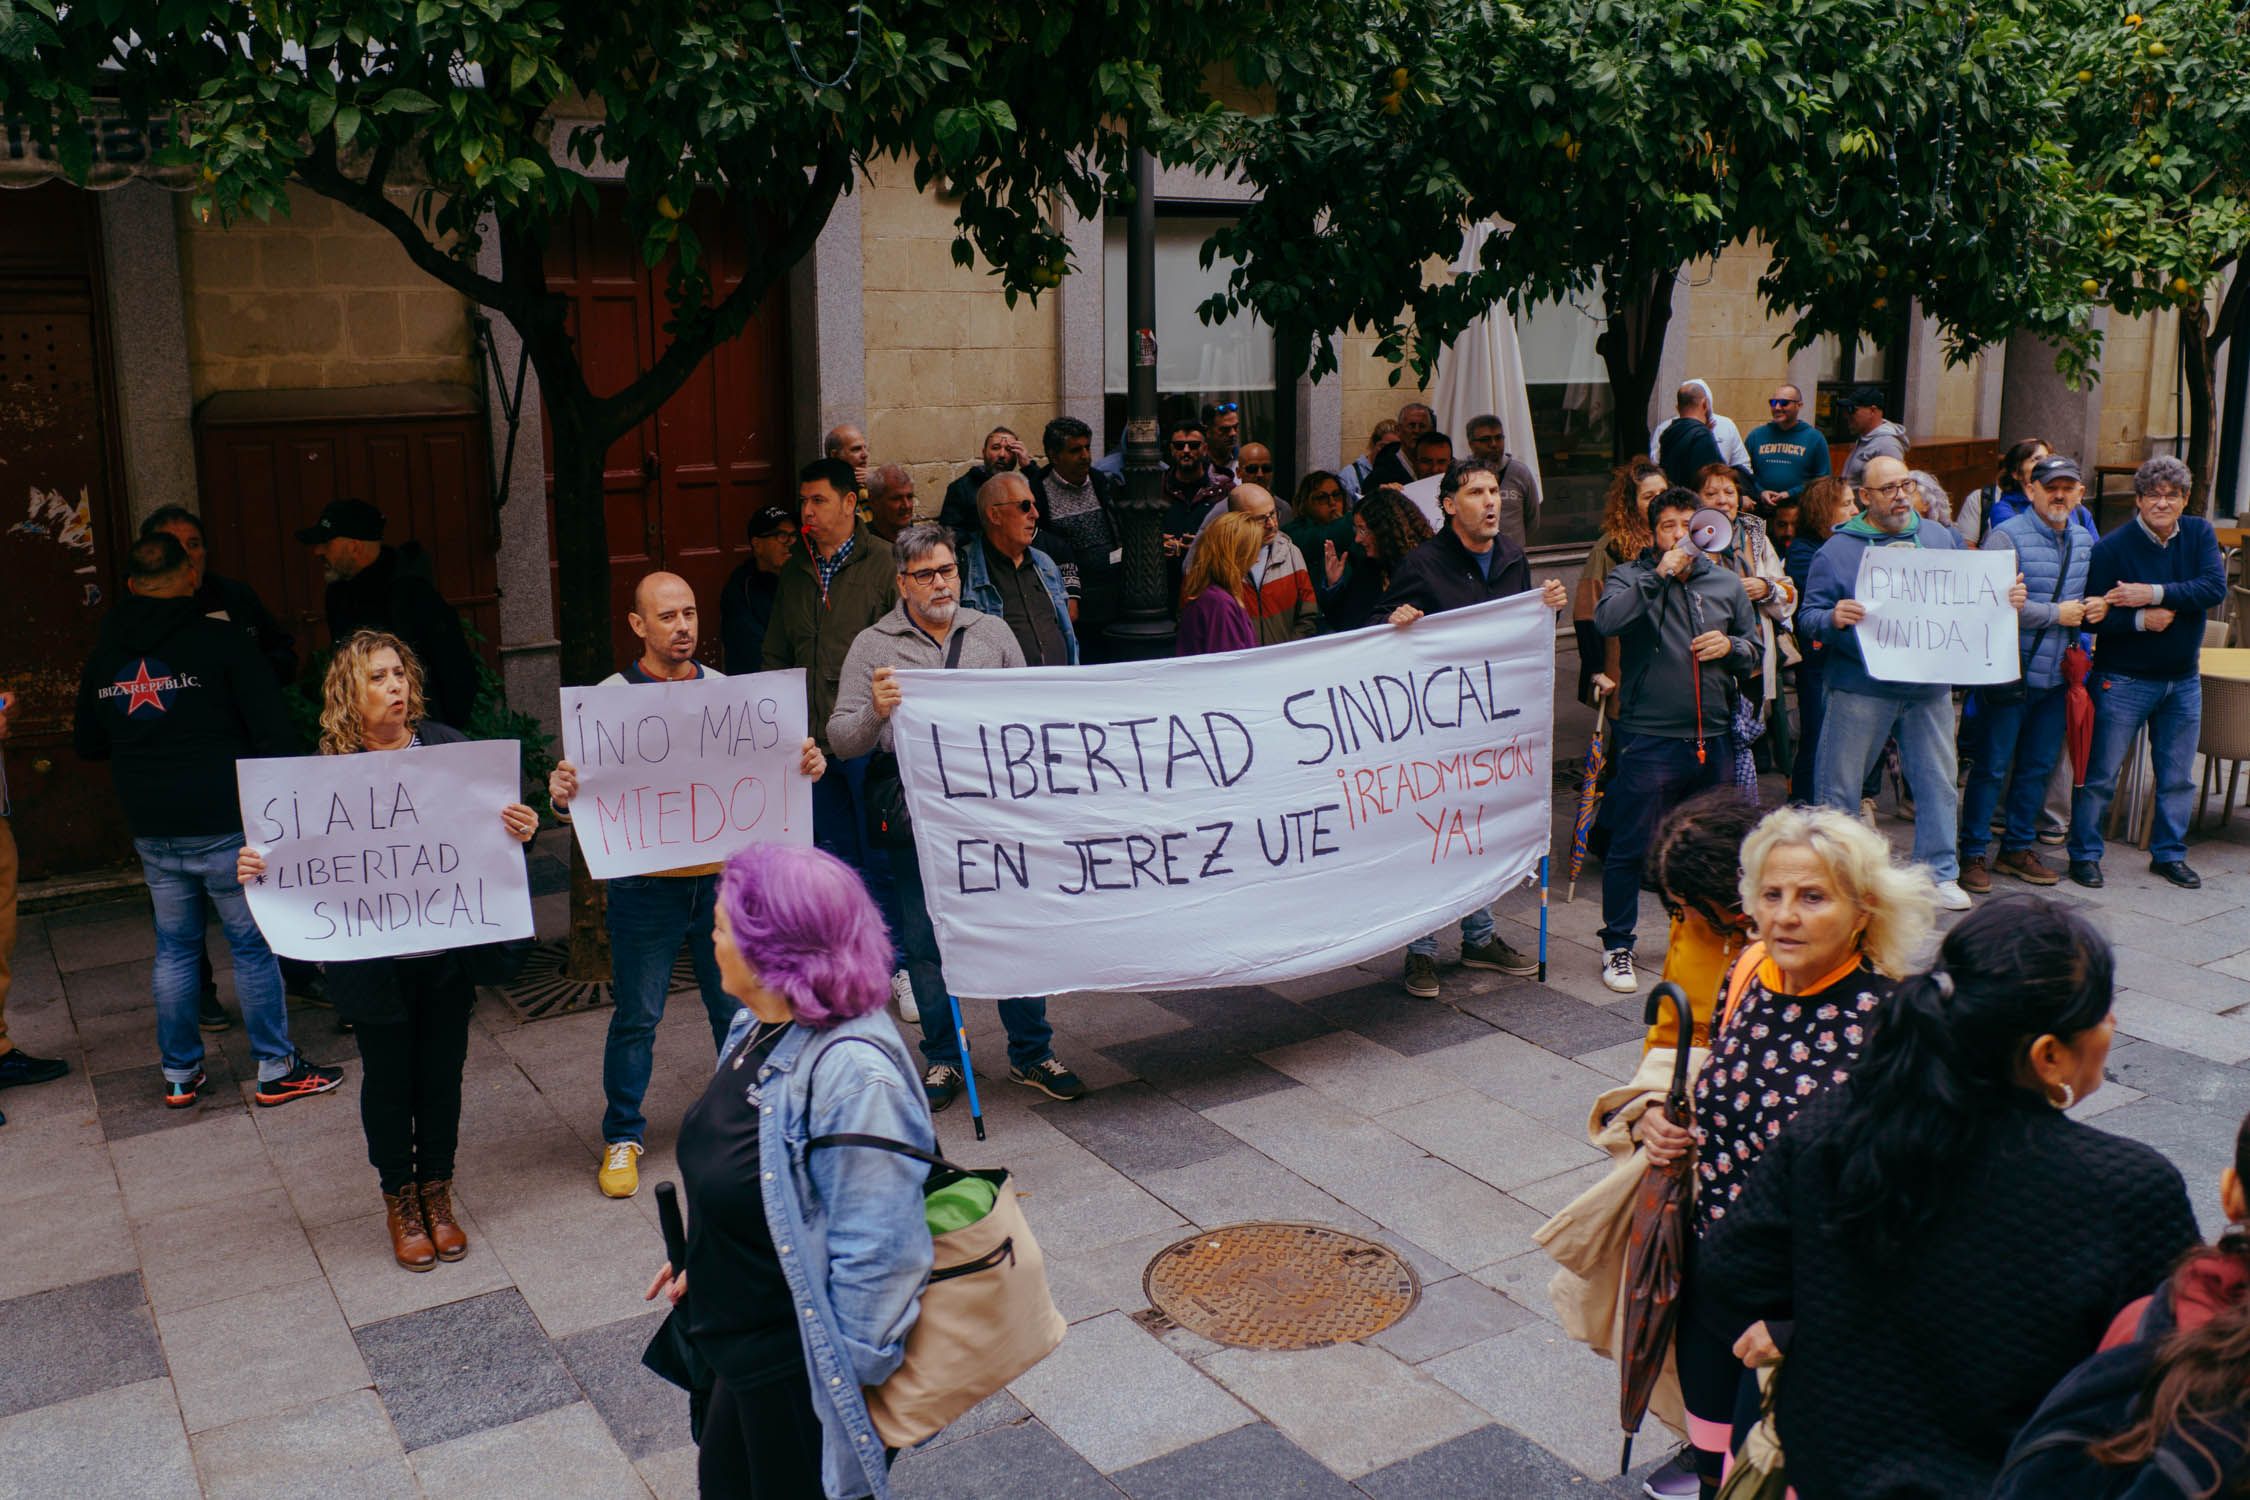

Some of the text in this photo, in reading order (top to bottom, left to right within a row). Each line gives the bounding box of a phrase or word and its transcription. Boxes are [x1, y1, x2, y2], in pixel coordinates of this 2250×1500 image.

[1759, 442, 1806, 457] KENTUCKY
[98, 684, 130, 700] IBIZA
[701, 698, 779, 758] MAS
[931, 660, 1521, 799] LIBERTAD SINDICAL
[326, 792, 354, 835] A
[370, 782, 419, 830] LA
[1337, 735, 1534, 831] ¡READMISIÓN
[957, 803, 1340, 895] EN JEREZ UTE
[1416, 803, 1485, 864] YA!
[278, 843, 460, 889] LIBERTAD
[304, 877, 501, 940] SINDICAL
